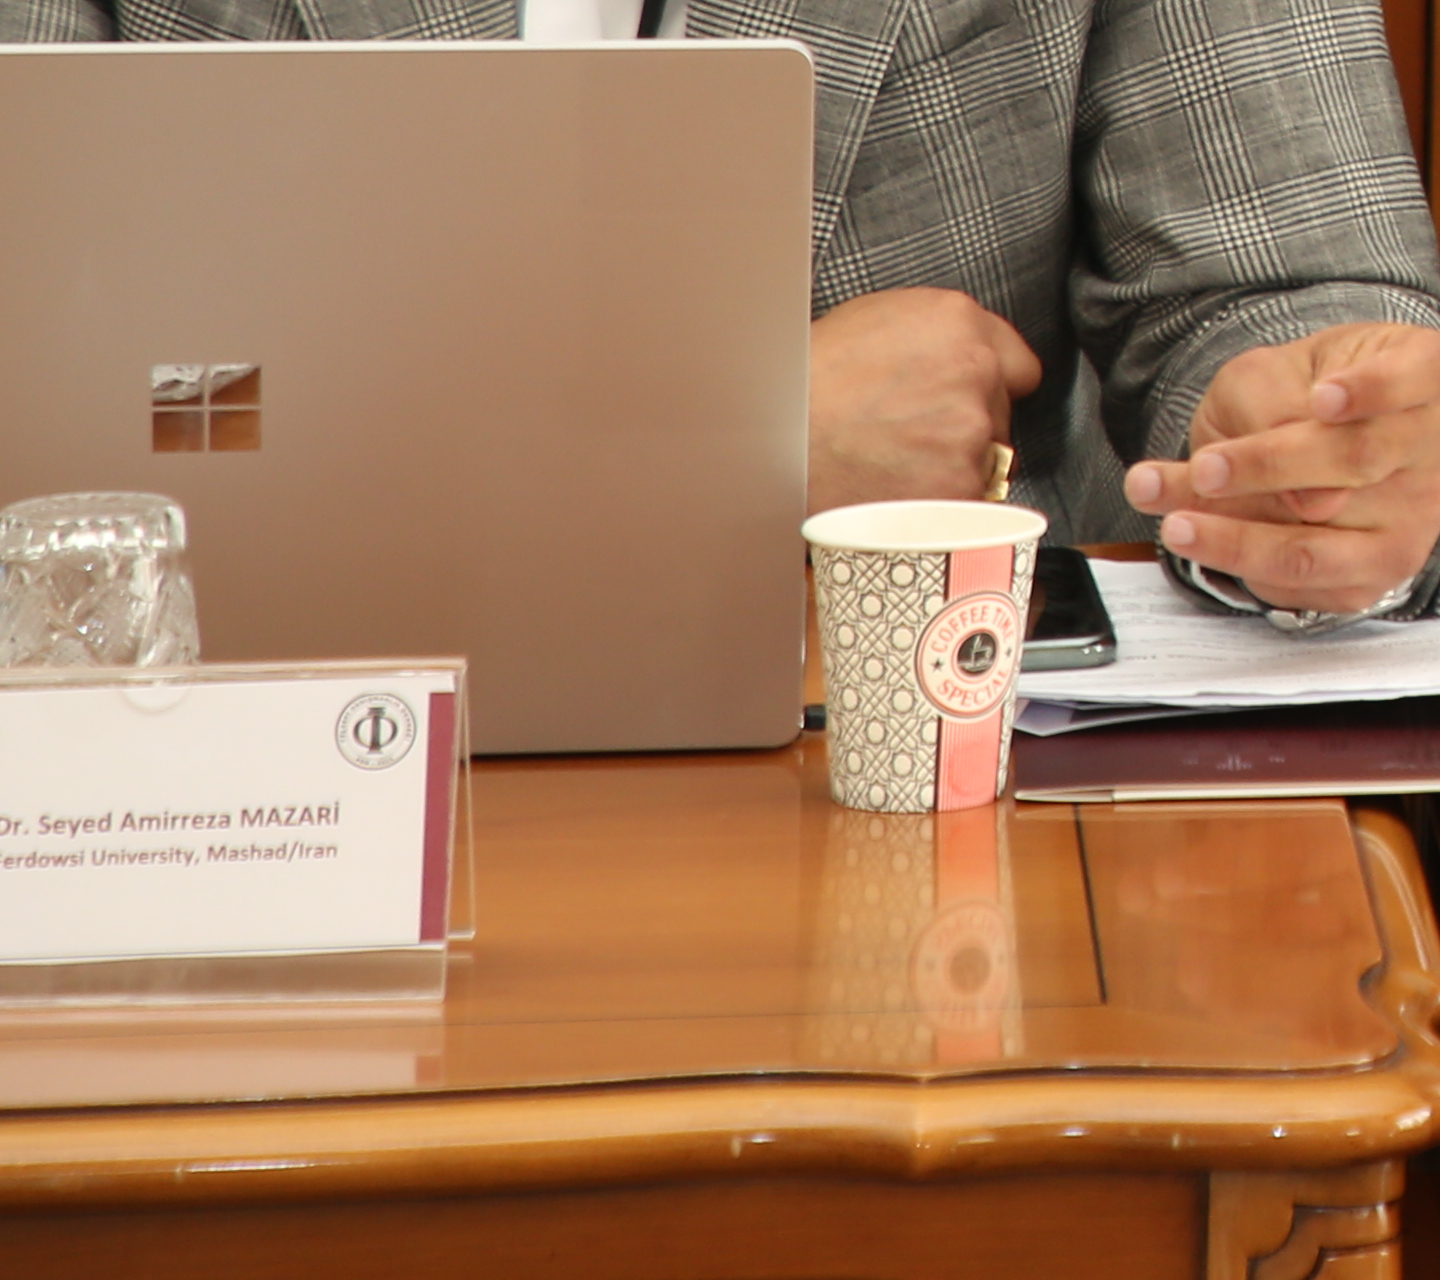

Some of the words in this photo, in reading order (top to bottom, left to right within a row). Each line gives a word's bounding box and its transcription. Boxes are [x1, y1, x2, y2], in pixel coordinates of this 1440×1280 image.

[930, 604, 990, 654] COFFEE
[936, 669, 1009, 708] SPECIAL
[37, 811, 112, 839] Seyed
[119, 808, 232, 834] Amirreza
[240, 800, 341, 828] MAZARİ
[0, 848, 86, 871] erdowsi
[91, 846, 201, 868] University,
[206, 841, 338, 865] Mashad/Iran
